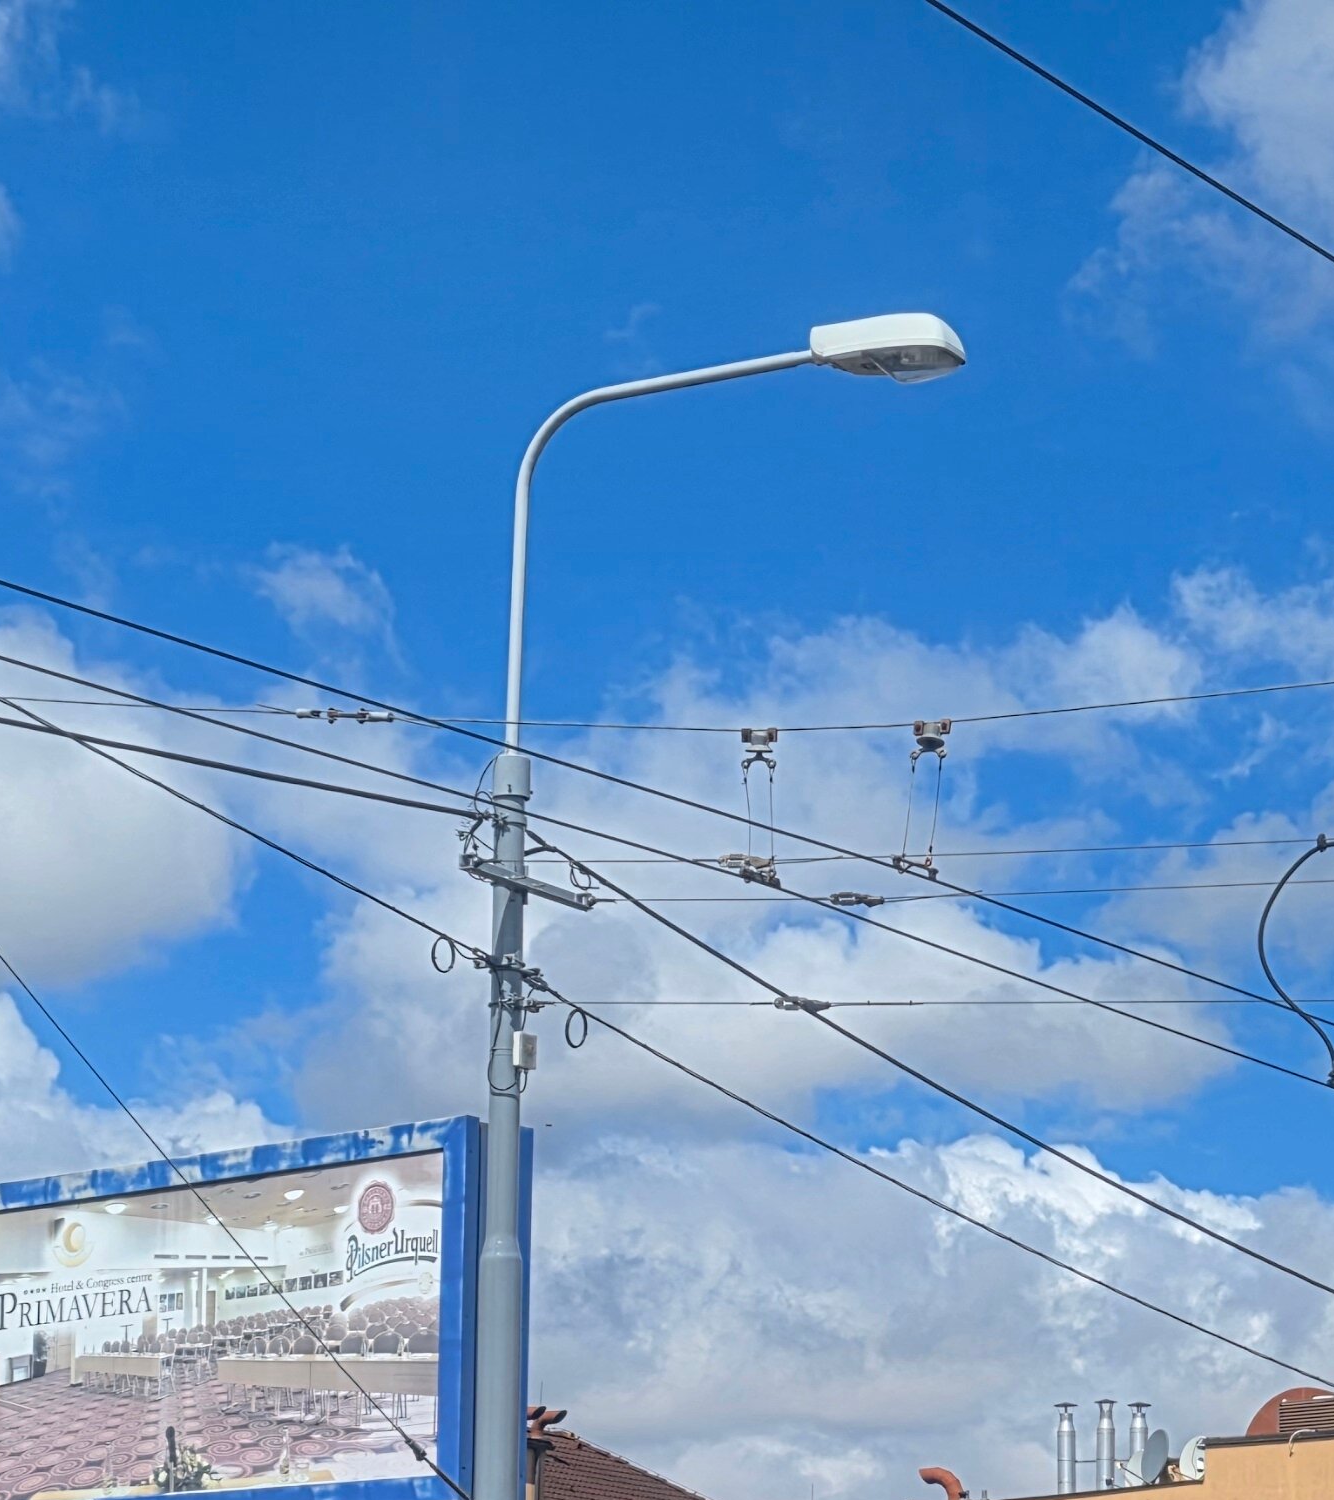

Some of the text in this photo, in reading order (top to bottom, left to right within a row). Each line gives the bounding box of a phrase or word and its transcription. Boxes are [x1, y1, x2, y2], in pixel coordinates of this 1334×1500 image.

[346, 1227, 439, 1283] Pilsner Urquell
[51, 1273, 152, 1294] Hotel & Congress centre
